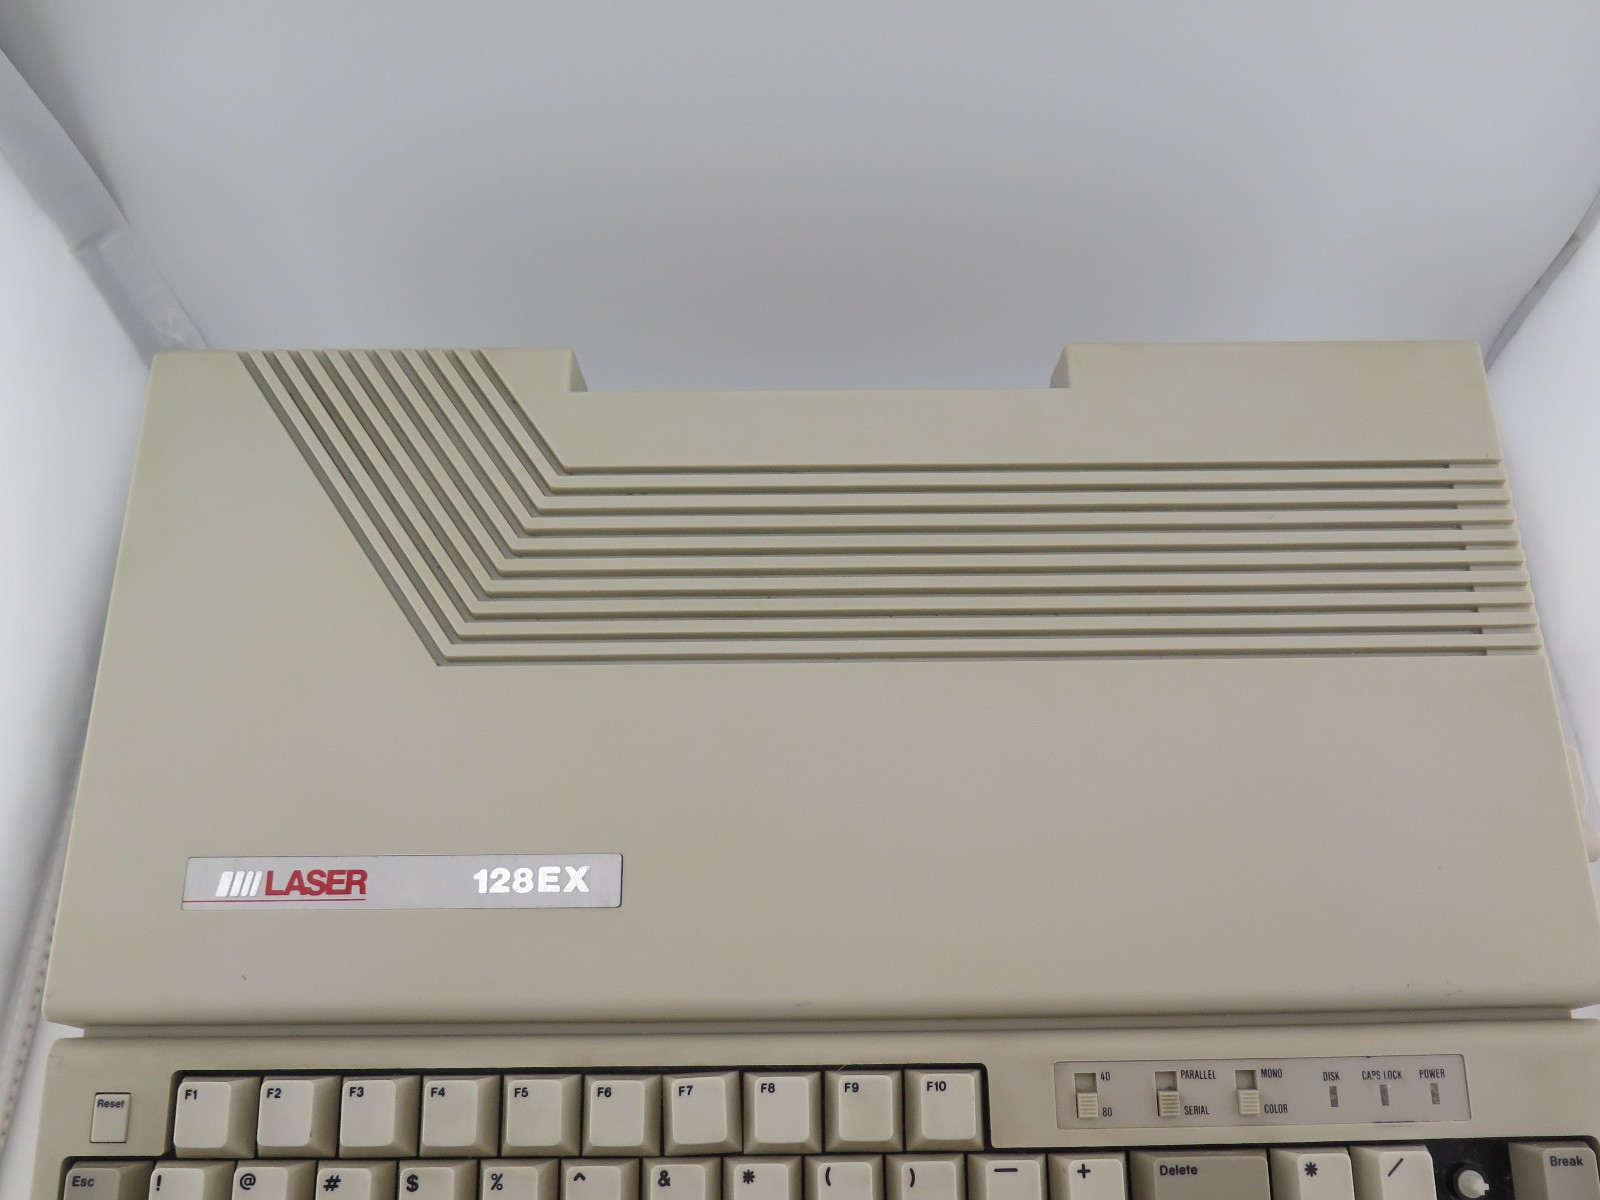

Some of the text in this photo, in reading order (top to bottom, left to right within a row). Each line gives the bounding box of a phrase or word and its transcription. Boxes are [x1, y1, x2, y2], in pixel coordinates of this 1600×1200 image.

[266, 866, 590, 896] LASER 128EX
[1100, 1071, 1111, 1082] 40
[1180, 1069, 1217, 1080] PARALLEL
[1260, 1068, 1283, 1079] MONO
[1323, 1071, 1341, 1081] DISK
[1361, 1070, 1402, 1080] CAPS LOCK
[1418, 1068, 1446, 1079] POWER
[349, 1086, 364, 1098] F3
[430, 1086, 446, 1098] F4
[514, 1086, 529, 1098] F5
[597, 1086, 612, 1098] F6
[678, 1084, 694, 1097] F7
[760, 1082, 776, 1094] F8
[844, 1082, 860, 1093] F9
[926, 1080, 947, 1092] F10
[184, 1089, 198, 1099] F1
[266, 1088, 281, 1098] F2
[97, 1098, 125, 1109] Reset
[1263, 1103, 1288, 1114] COLOR
[1102, 1106, 1113, 1117] 80
[1183, 1105, 1210, 1116] SERIAL
[1549, 1155, 1584, 1167] Break
[1076, 1163, 1091, 1179] +
[1159, 1164, 1198, 1176] Delete
[71, 1176, 95, 1187] Esc
[240, 1173, 256, 1190] @
[490, 1173, 504, 1191] %
[657, 1169, 671, 1188] &
[825, 1166, 832, 1187] (
[909, 1167, 916, 1188] )
[156, 1176, 162, 1191] !
[323, 1176, 341, 1191] #
[406, 1173, 419, 1193] $
